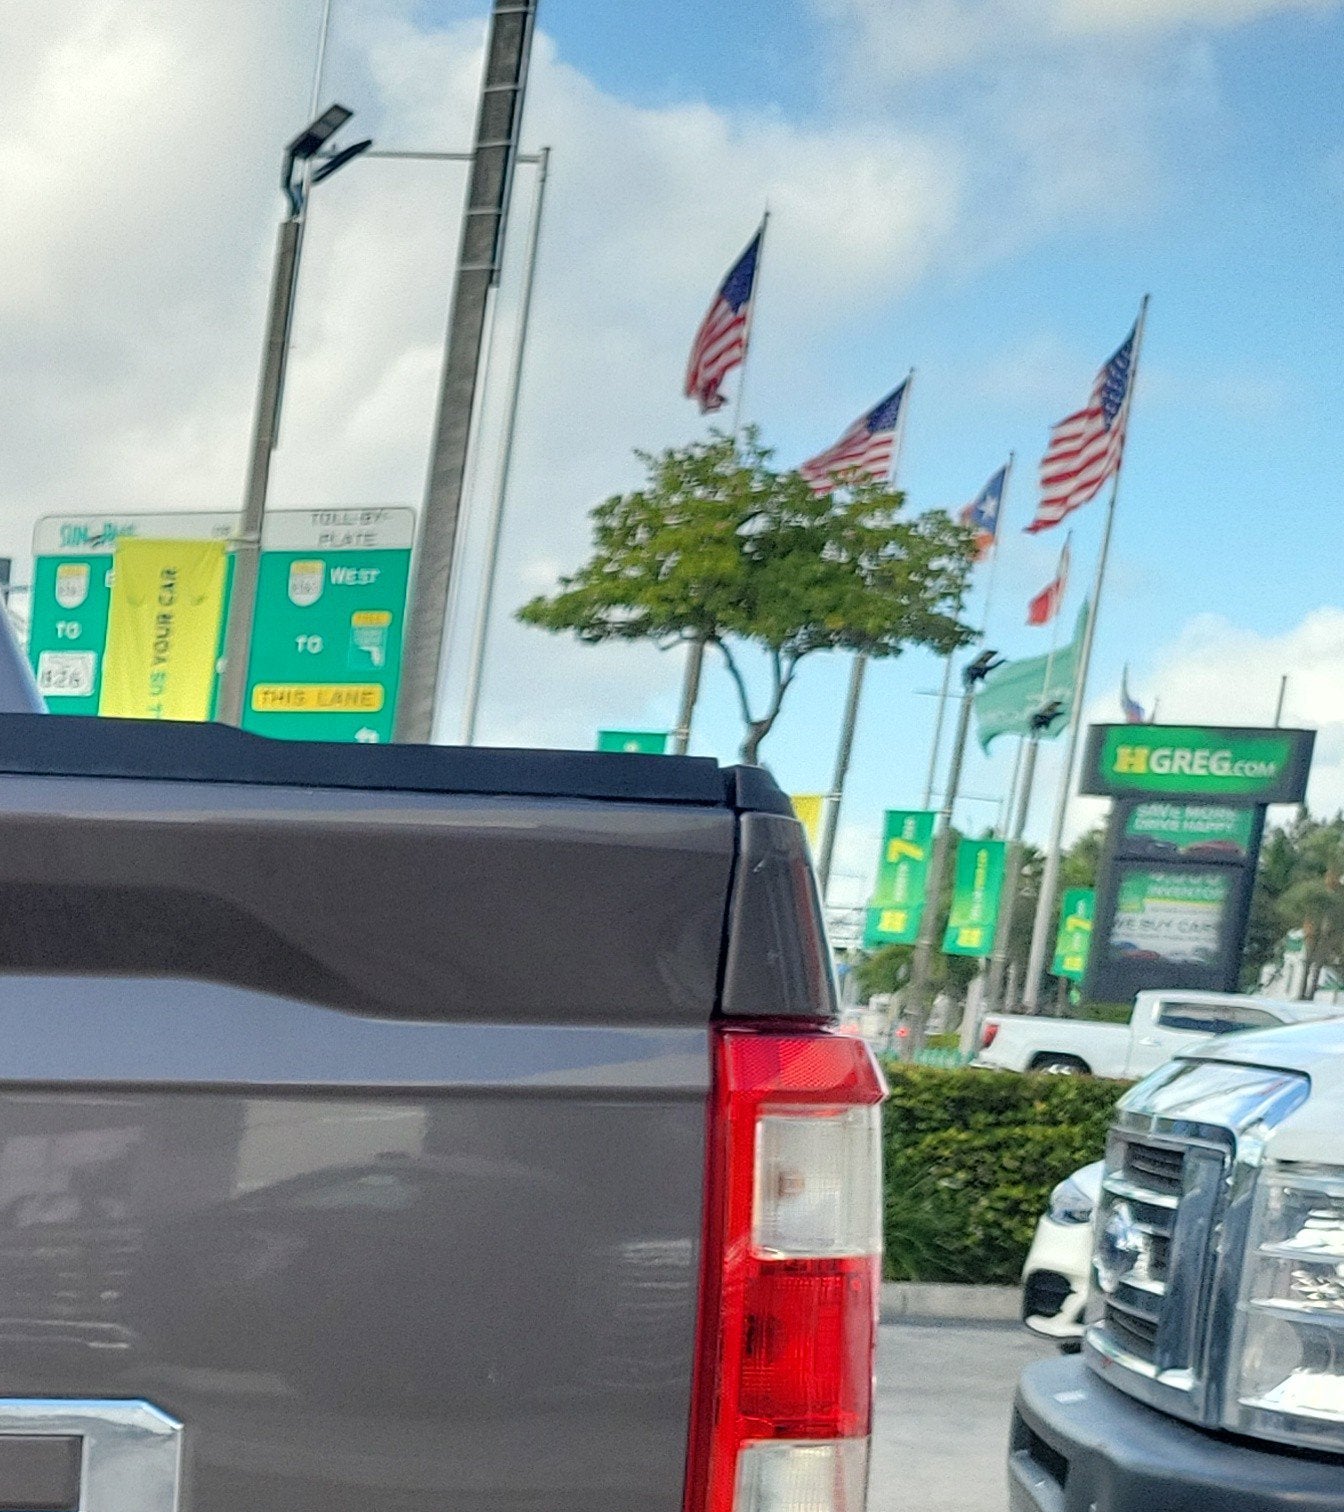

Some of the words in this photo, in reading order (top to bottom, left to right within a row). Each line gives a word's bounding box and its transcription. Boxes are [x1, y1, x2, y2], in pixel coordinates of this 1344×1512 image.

[158, 566, 179, 606] CAR
[330, 566, 381, 586] WEST
[55, 620, 83, 640] TO
[152, 613, 173, 666] YOUR
[295, 634, 324, 654] TO
[261, 689, 306, 707] THIS
[316, 689, 376, 708] LANE
